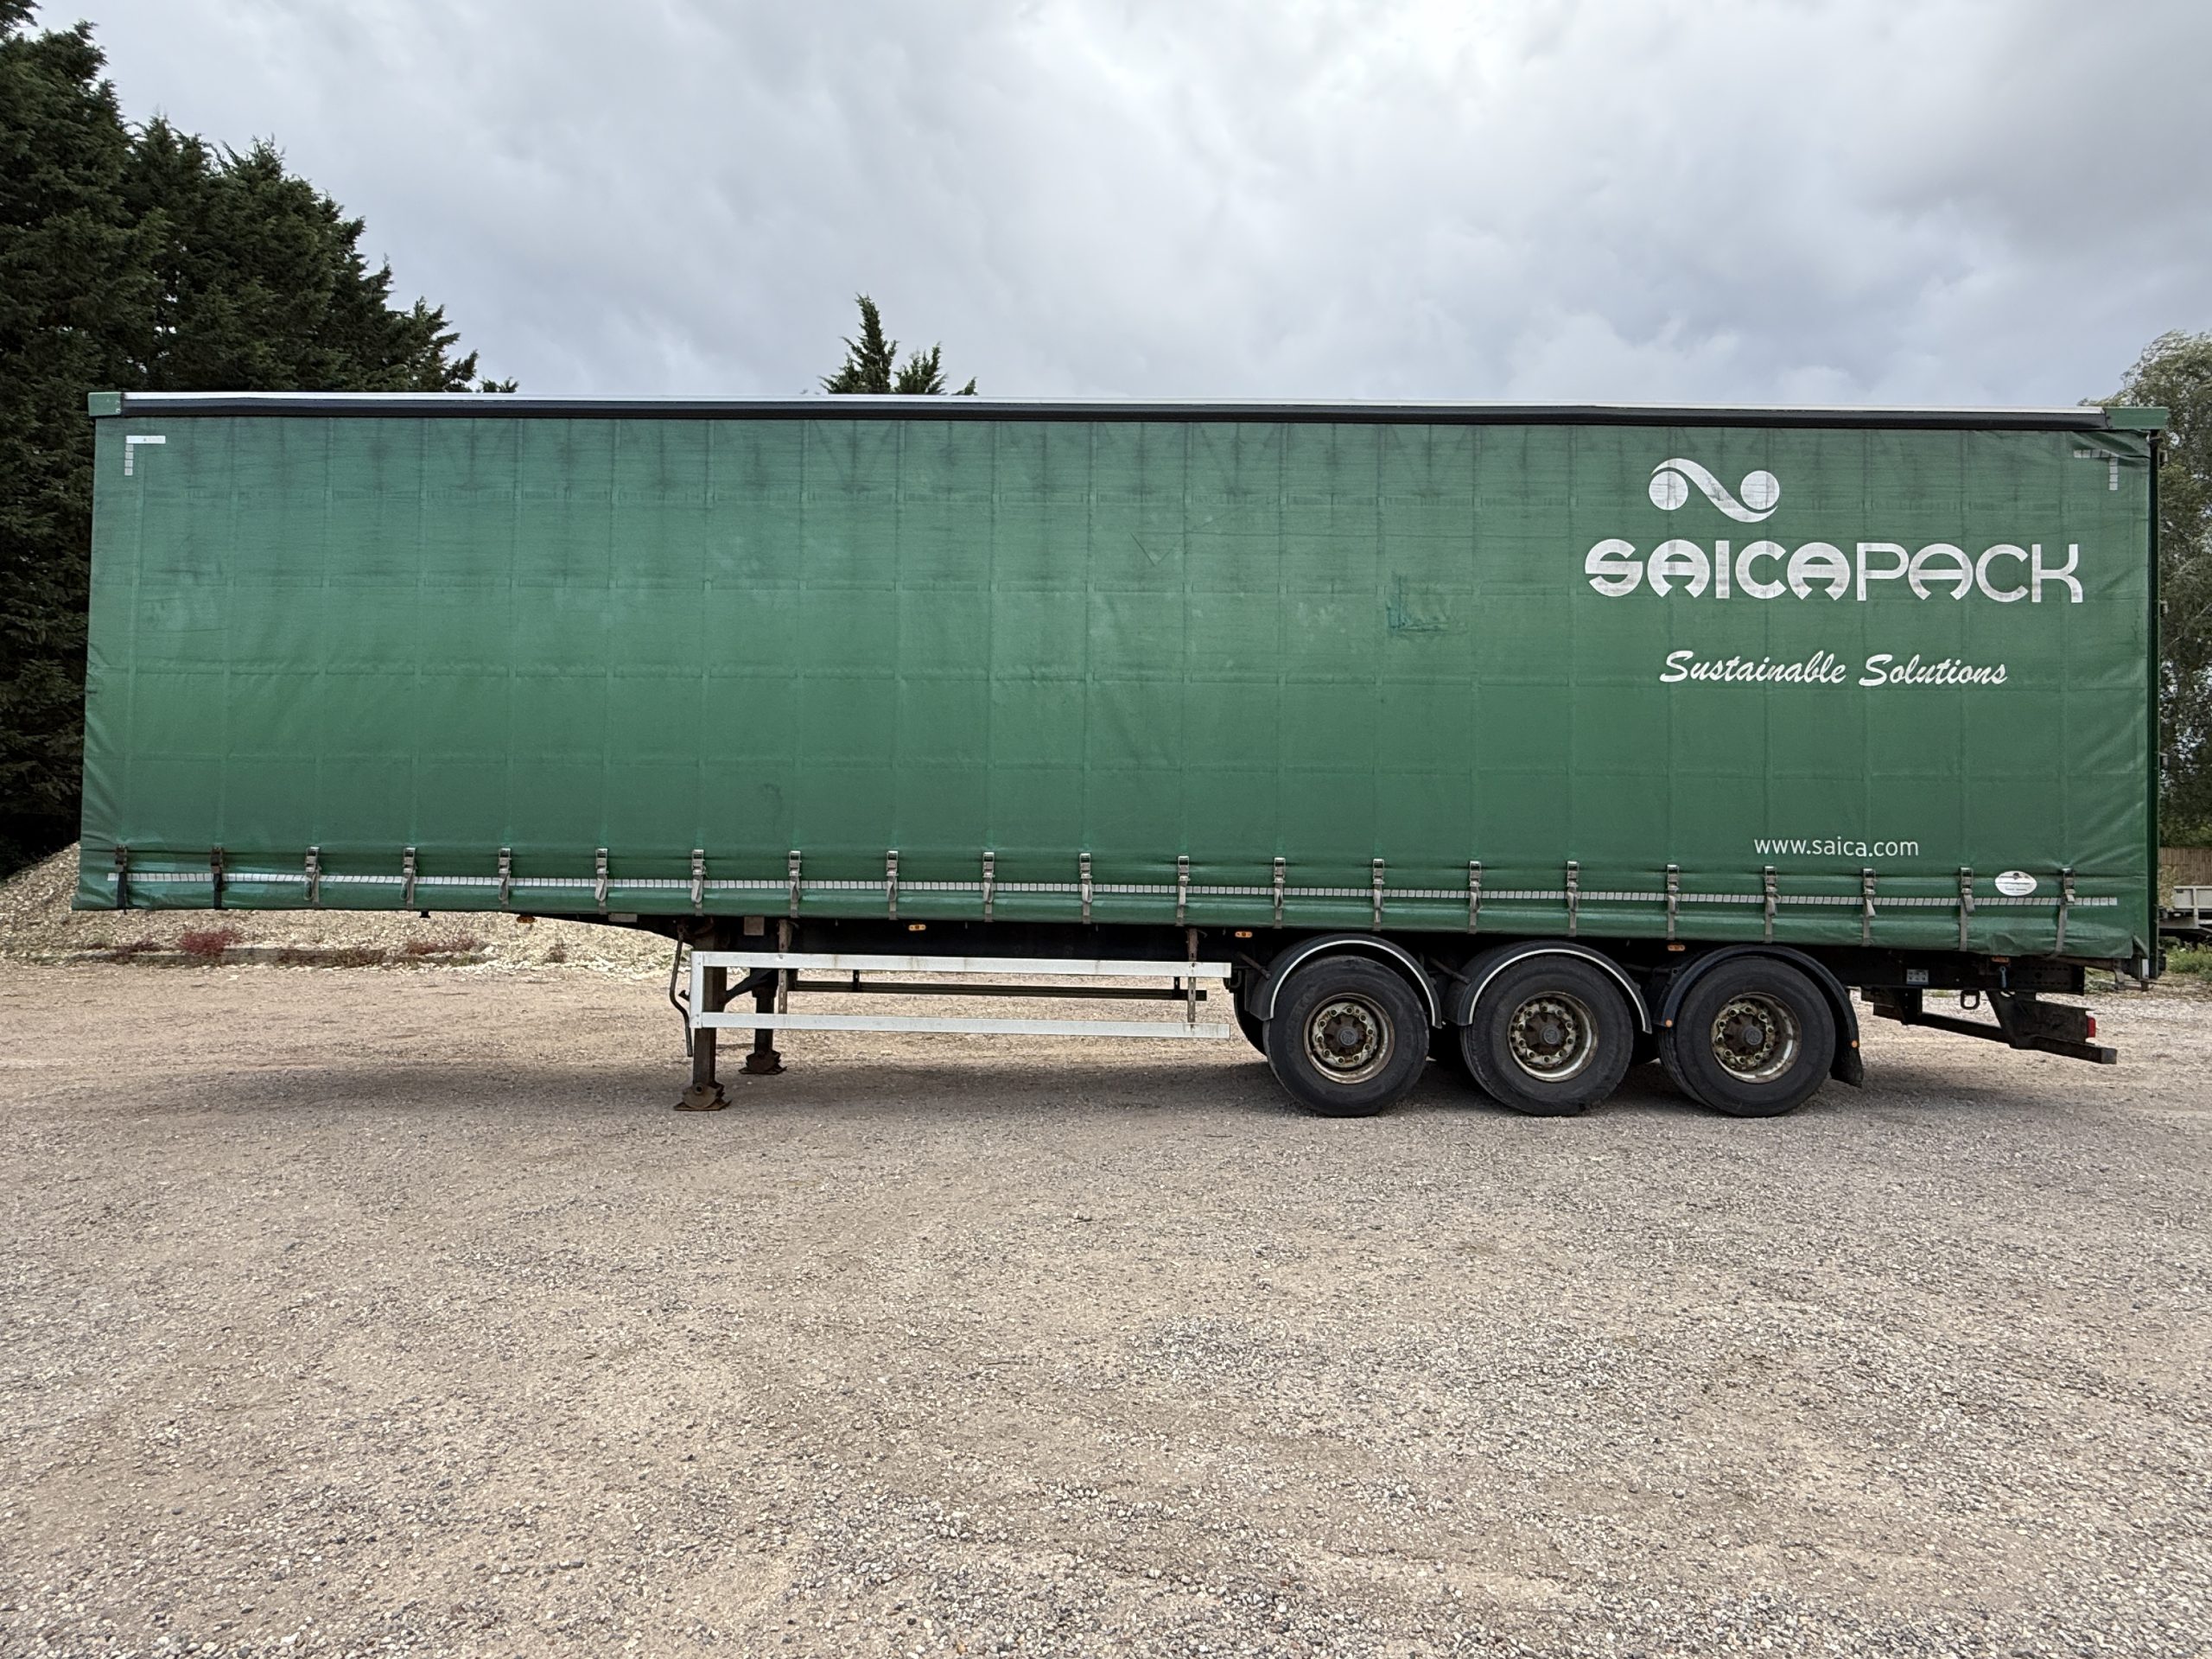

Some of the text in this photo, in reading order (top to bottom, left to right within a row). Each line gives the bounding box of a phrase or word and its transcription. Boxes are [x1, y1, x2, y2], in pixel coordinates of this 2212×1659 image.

[1585, 539, 2083, 603] SAICAPACK
[1659, 650, 2008, 687] Sustainable Solutions
[1754, 836, 1919, 857] www.saica.com
